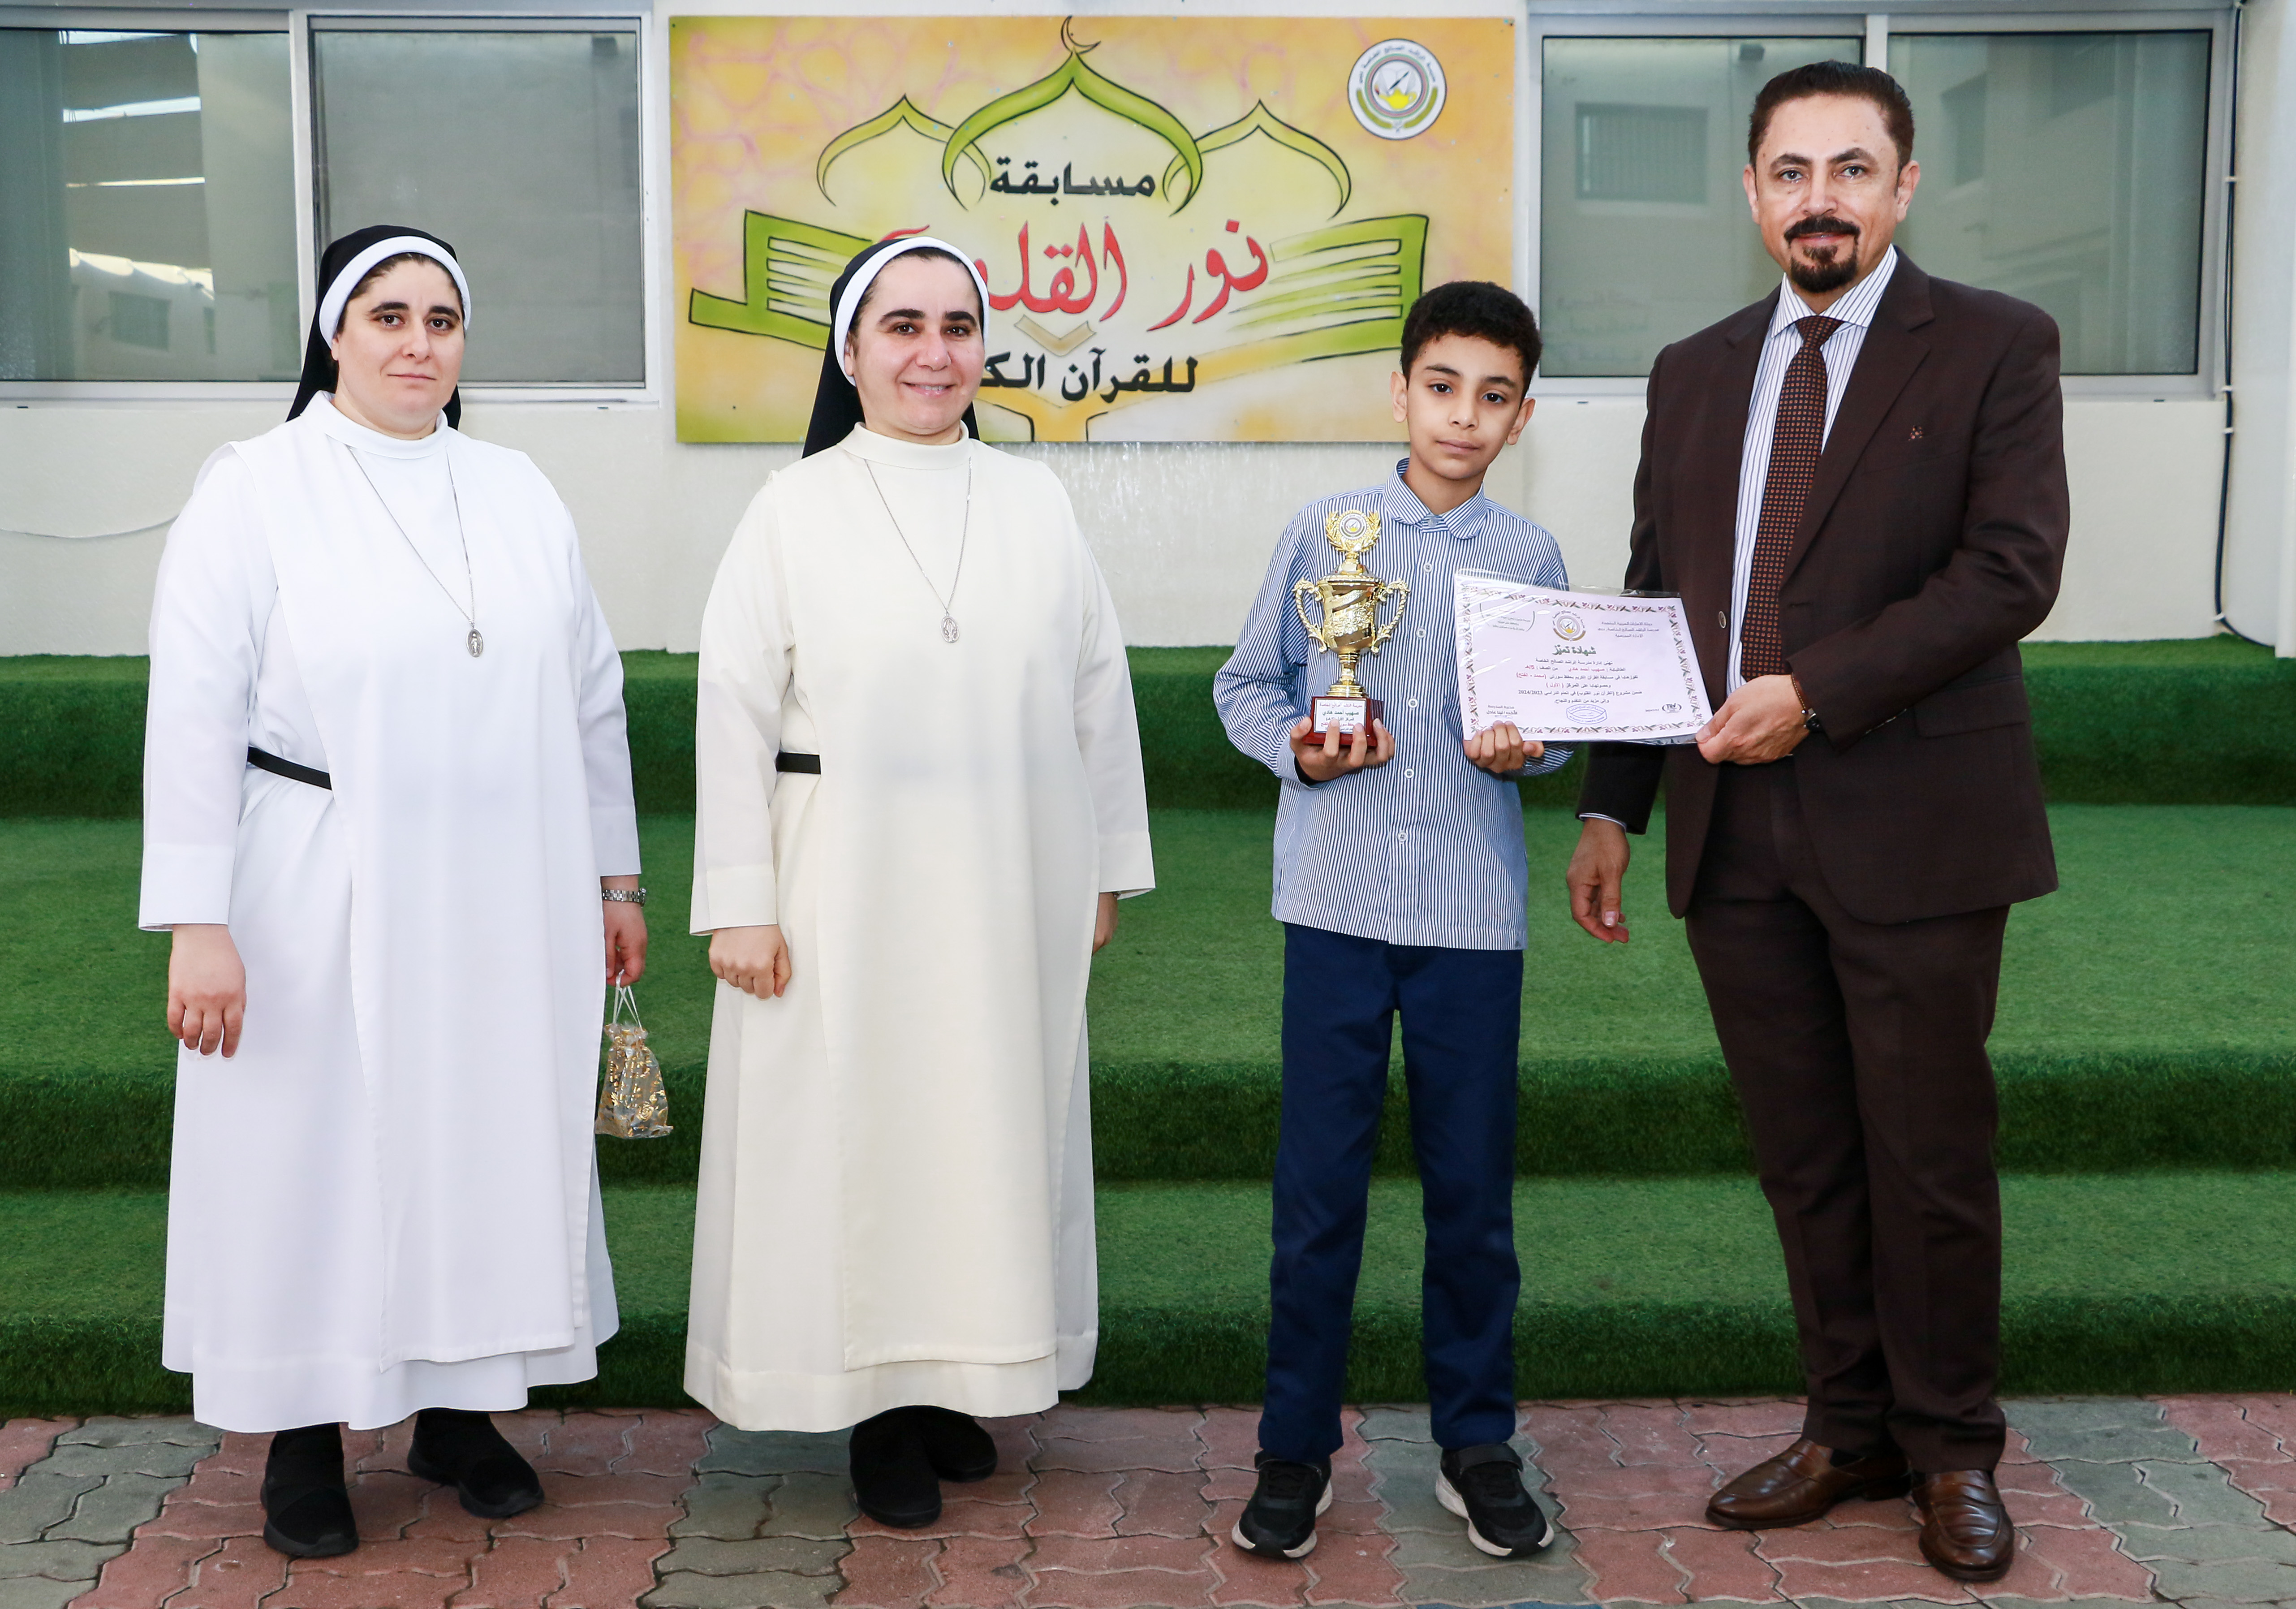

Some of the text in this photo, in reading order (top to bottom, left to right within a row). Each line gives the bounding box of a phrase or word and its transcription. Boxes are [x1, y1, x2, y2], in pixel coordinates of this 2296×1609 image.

[989, 156, 1156, 205] مسابقة
[880, 220, 1269, 332] نور القل
[982, 347, 1198, 404] للقرآن الك
[1572, 646, 1596, 656] شهادة
